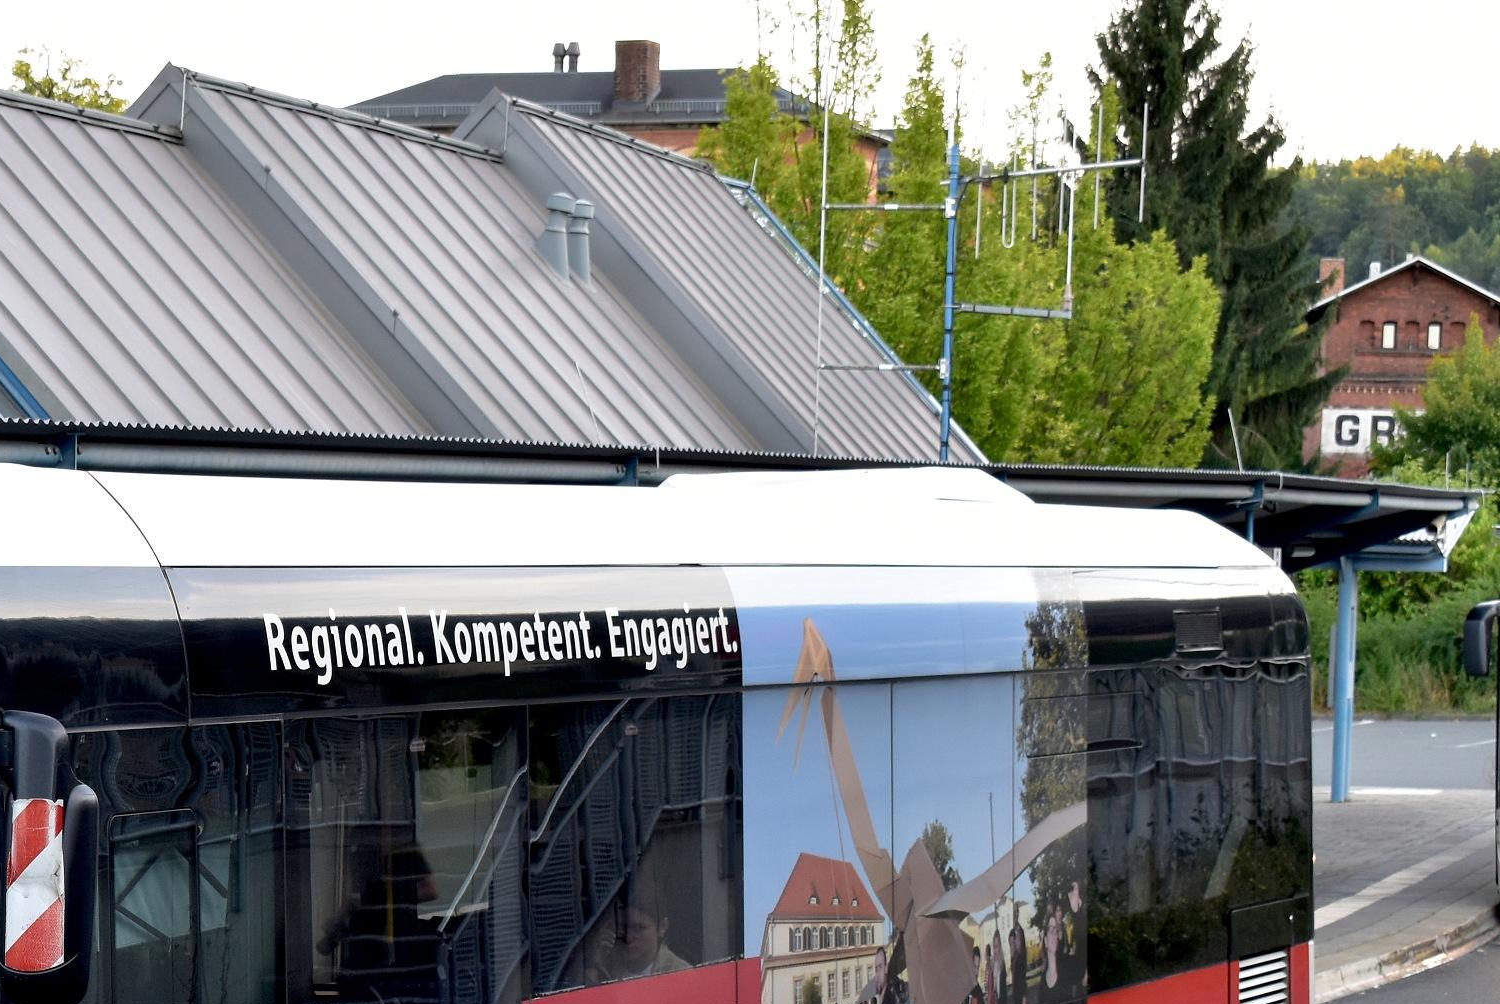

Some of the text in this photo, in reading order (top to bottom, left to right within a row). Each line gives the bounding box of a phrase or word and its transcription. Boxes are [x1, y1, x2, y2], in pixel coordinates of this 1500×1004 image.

[263, 603, 739, 685] Regional. Kompetent. Engagiert.
